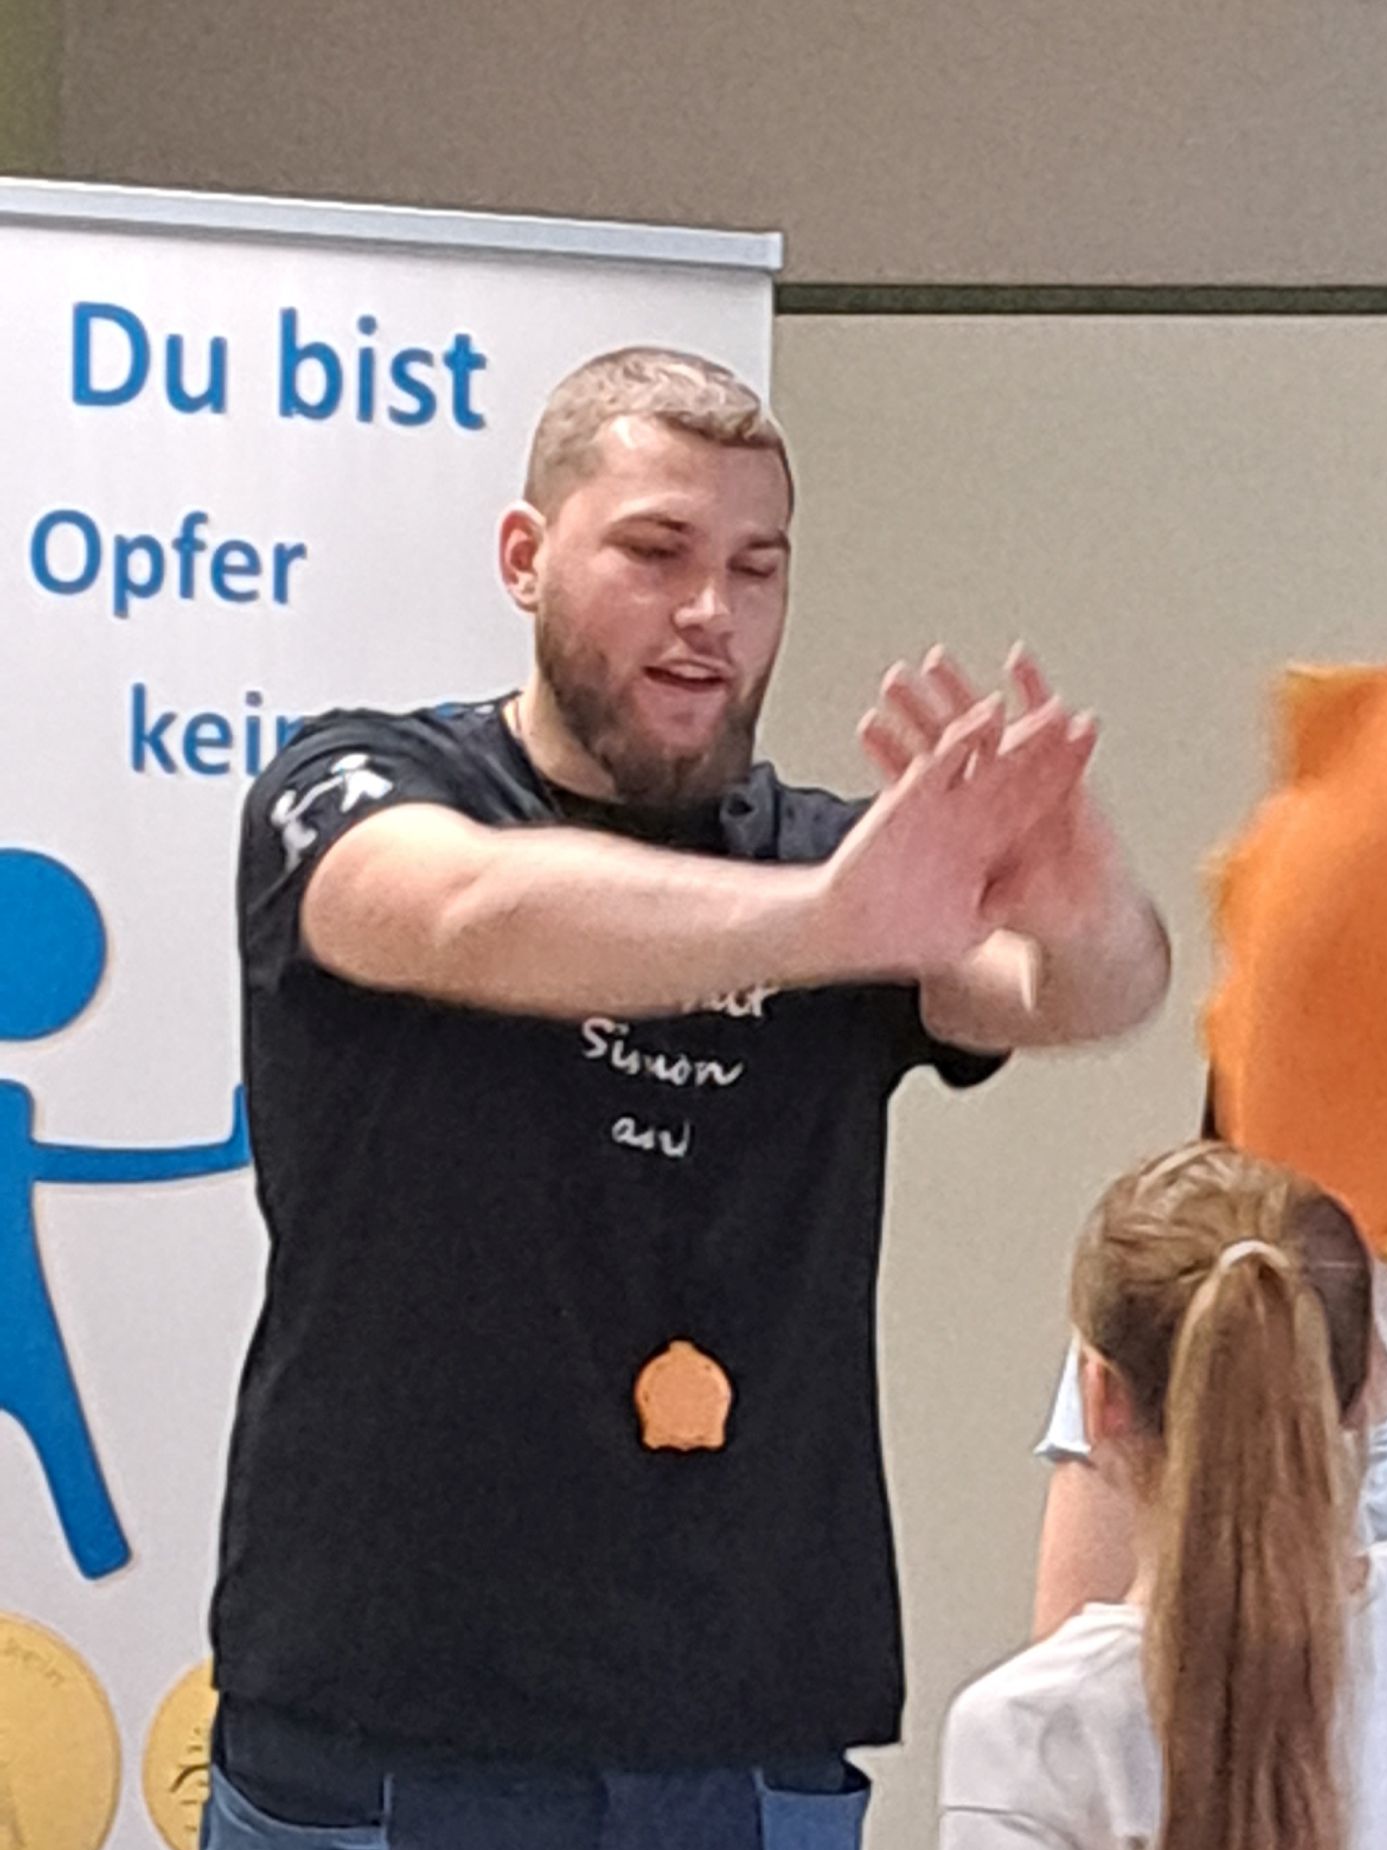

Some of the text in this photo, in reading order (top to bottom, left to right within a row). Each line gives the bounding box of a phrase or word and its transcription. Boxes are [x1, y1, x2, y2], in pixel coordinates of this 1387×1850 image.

[70, 300, 488, 431] Du bist
[29, 508, 308, 620] Opfer
